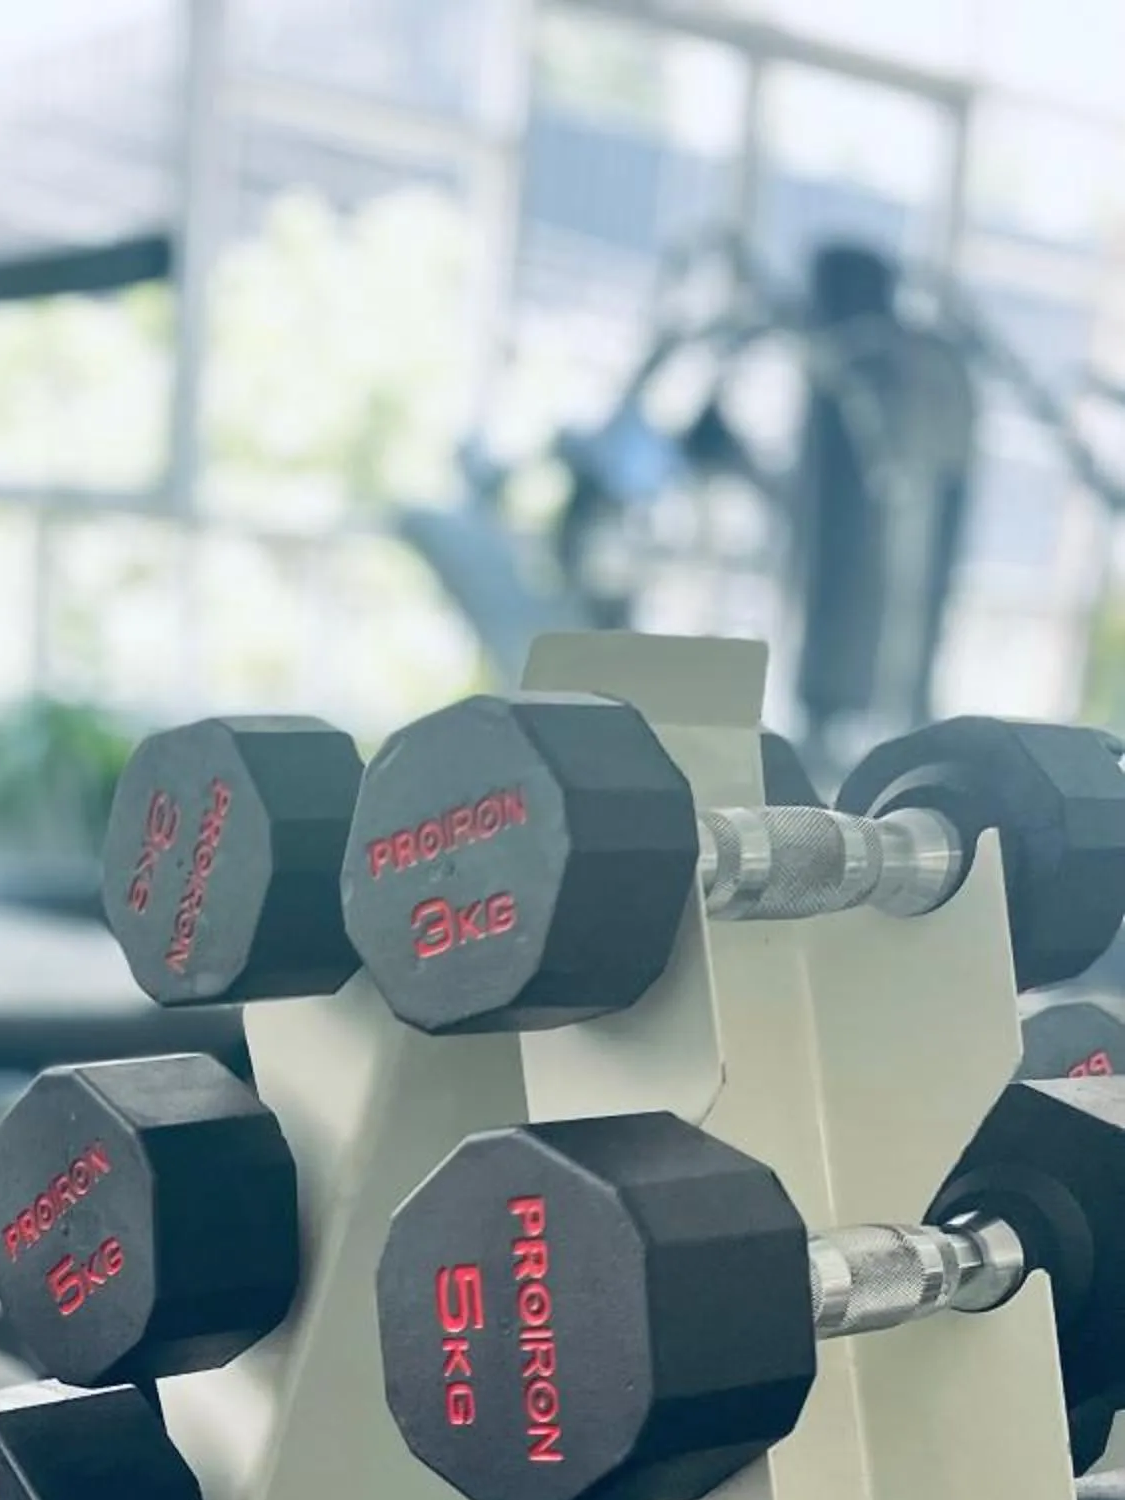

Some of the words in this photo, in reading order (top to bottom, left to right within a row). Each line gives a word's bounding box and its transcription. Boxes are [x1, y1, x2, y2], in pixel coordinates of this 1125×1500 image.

[164, 777, 231, 975] PROIRON
[366, 784, 526, 881] PROIRON
[410, 892, 518, 958] 3KG
[0, 1139, 113, 1262] PROIRON
[44, 1236, 125, 1317] 5KG
[507, 1195, 565, 1462] PROIRON
[435, 1262, 484, 1425] 5KG
